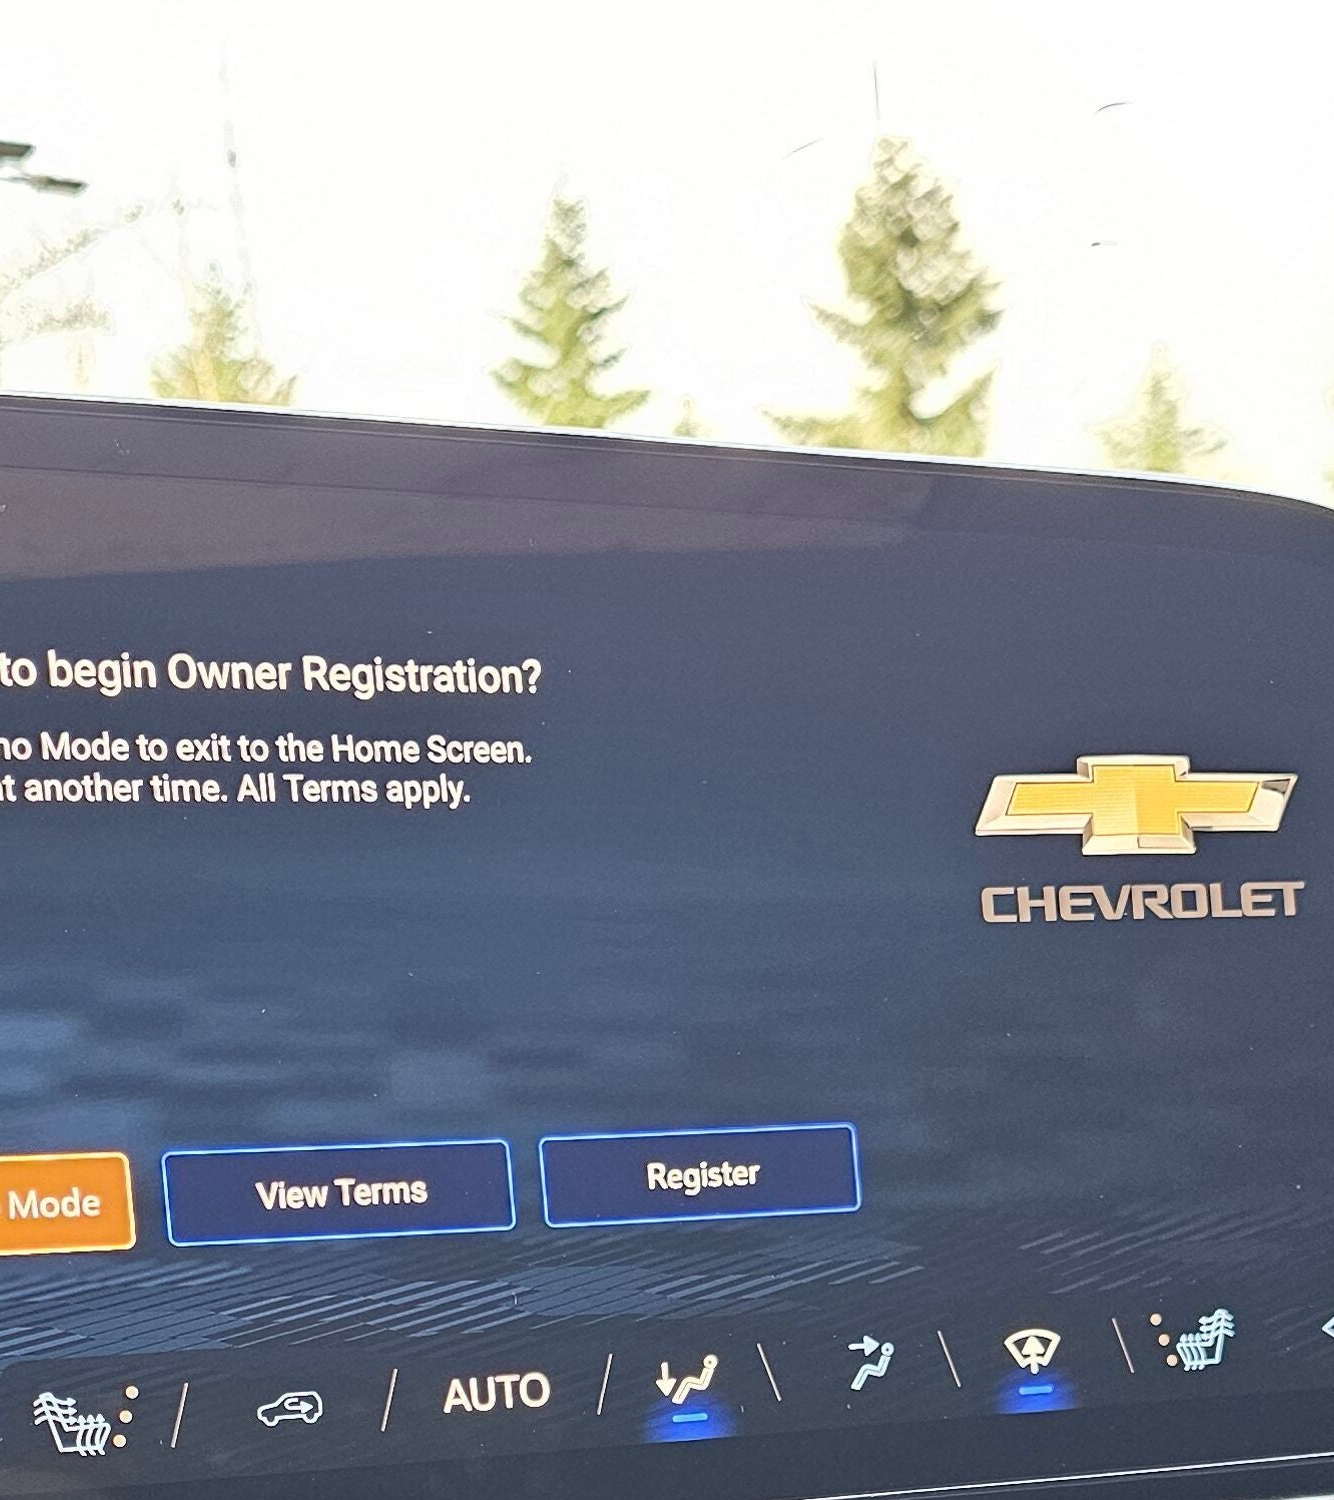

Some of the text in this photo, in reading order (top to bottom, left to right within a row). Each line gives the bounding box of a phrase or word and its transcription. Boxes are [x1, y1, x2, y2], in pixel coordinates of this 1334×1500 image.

[47, 648, 157, 697] begin
[167, 652, 293, 691] Owner
[301, 655, 542, 701] Registration?
[40, 730, 130, 761] Mode
[135, 733, 169, 762] to
[175, 732, 232, 762] exit
[236, 734, 270, 763] to
[274, 732, 324, 762] the
[330, 733, 421, 763] Home
[426, 734, 532, 764] Screen.
[24, 771, 144, 803] another
[150, 773, 228, 803] time.
[236, 772, 276, 803] All
[281, 773, 379, 803] Terms
[385, 772, 471, 810] apply.
[981, 880, 1306, 923] CHEVROLET
[254, 1177, 429, 1210] View Terms
[646, 1160, 761, 1196] Register
[8, 1186, 101, 1220] Mode
[443, 1371, 551, 1414] AUTO
